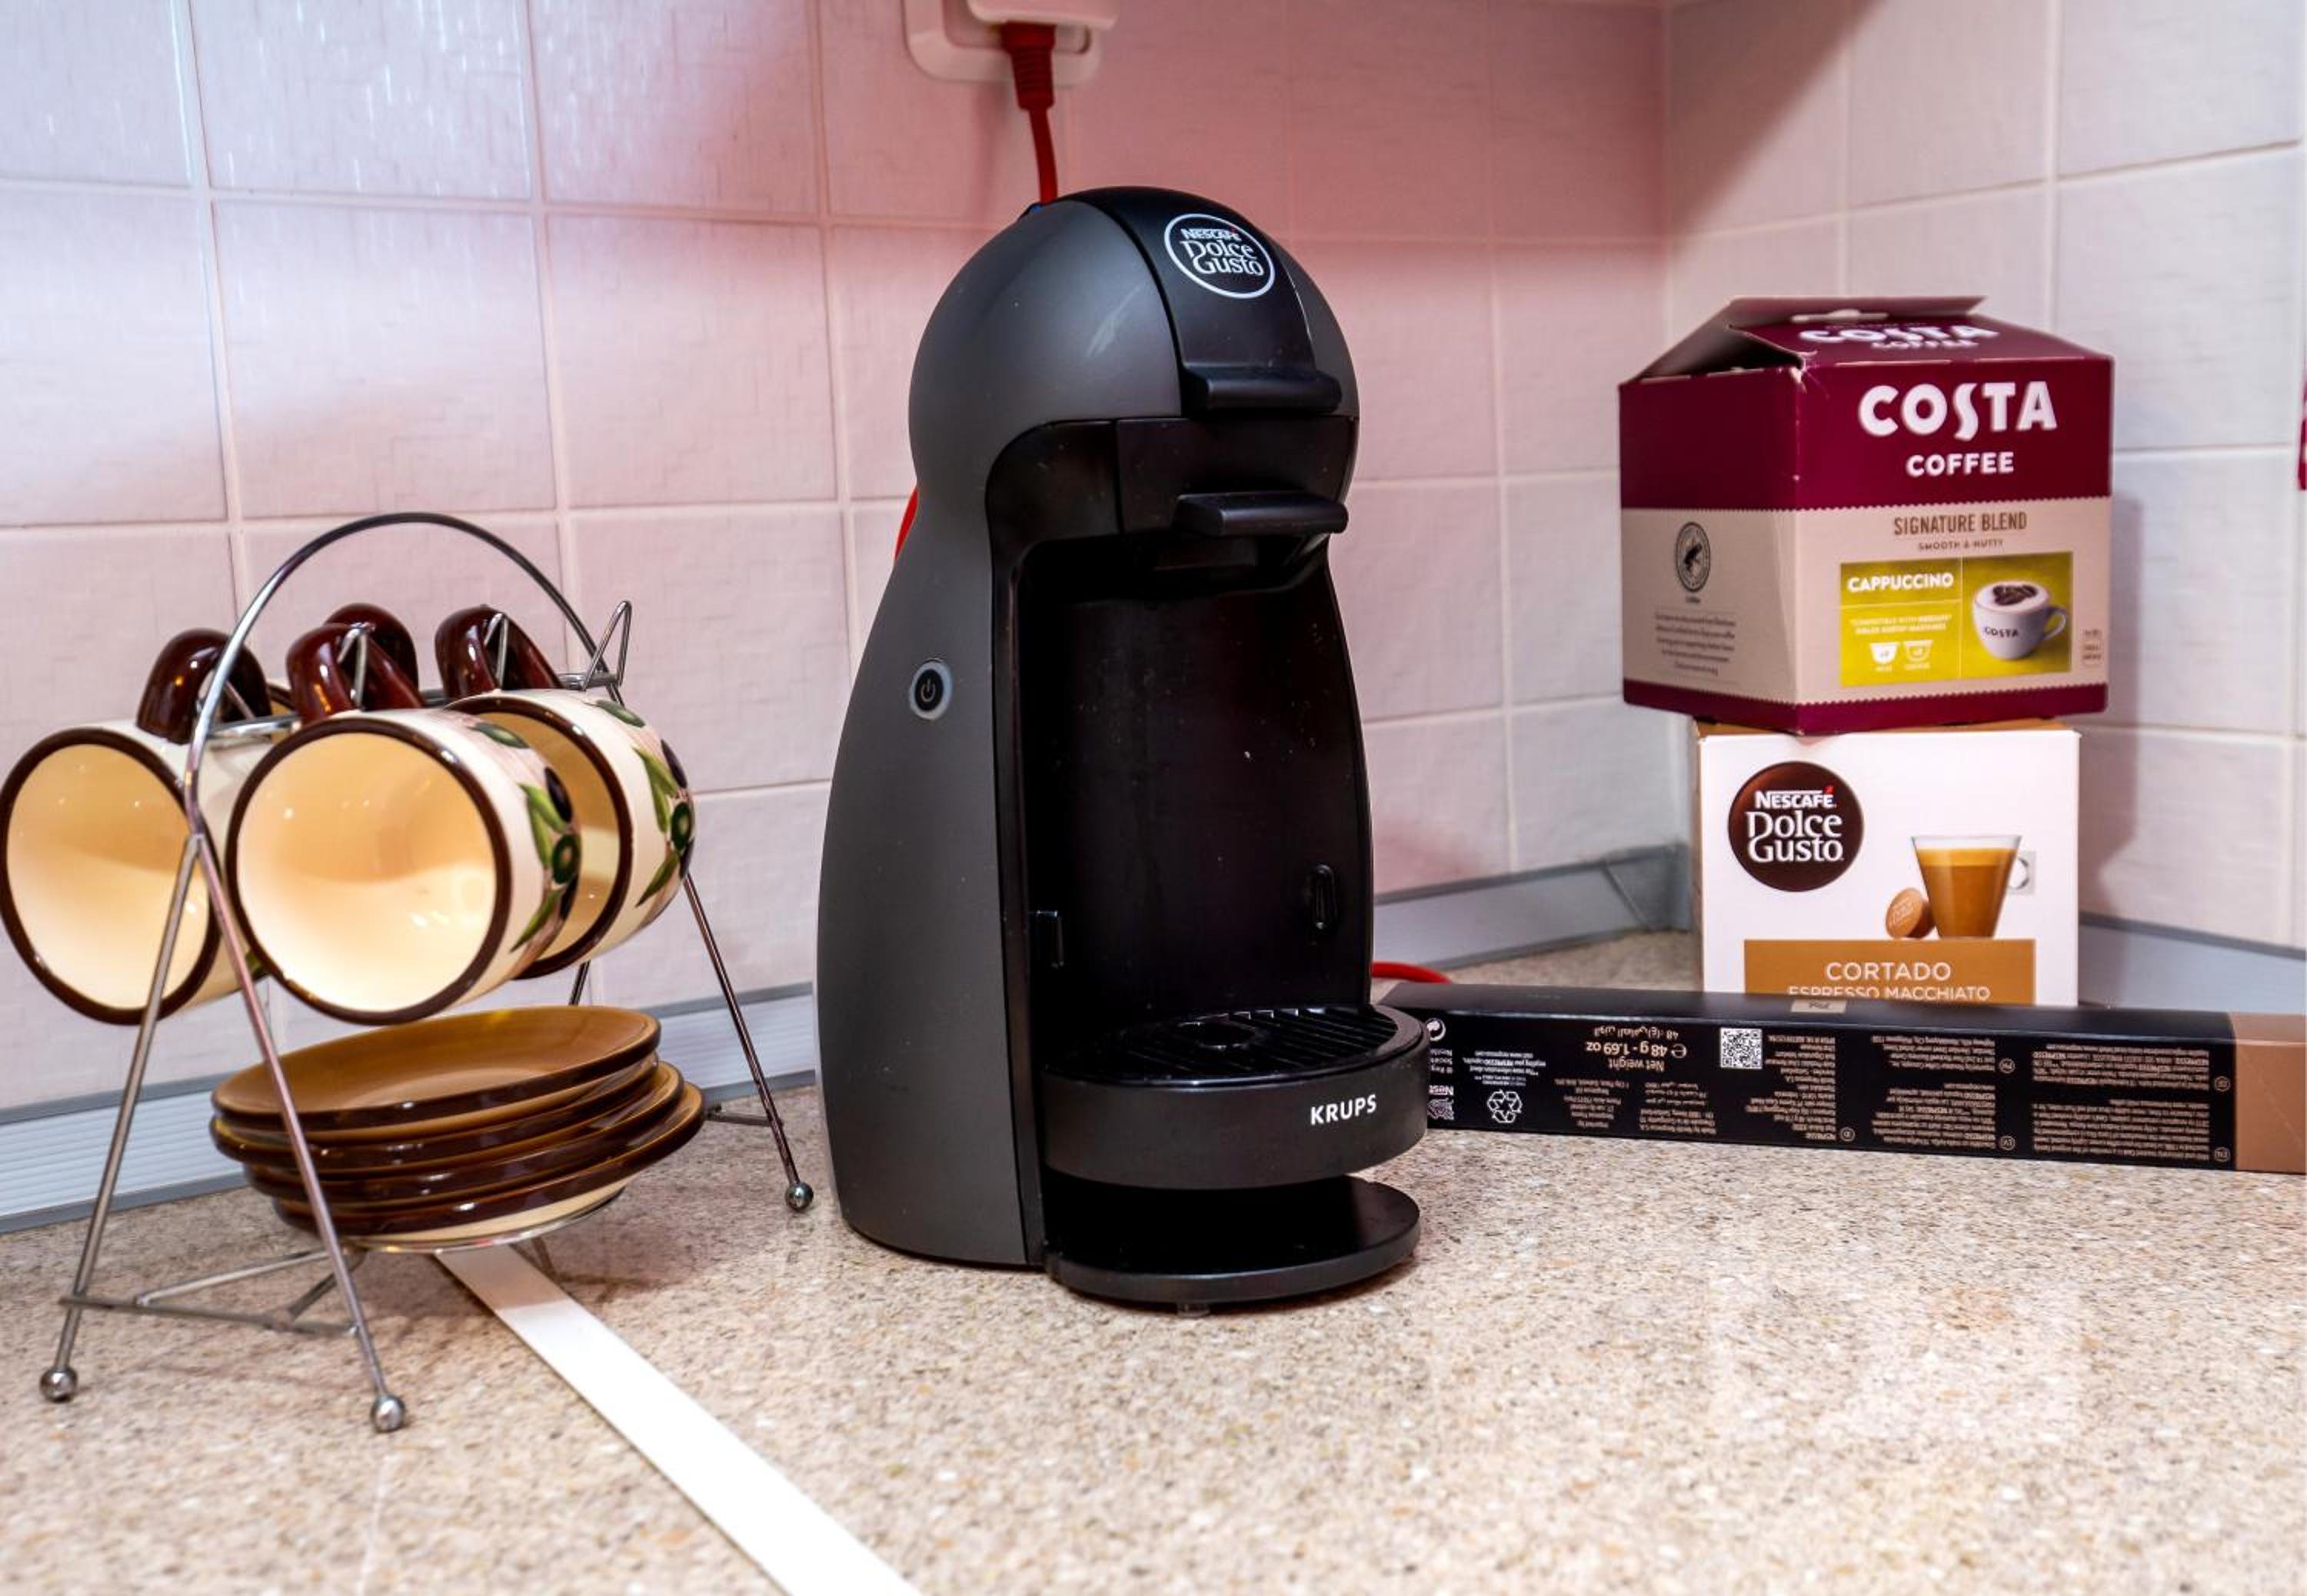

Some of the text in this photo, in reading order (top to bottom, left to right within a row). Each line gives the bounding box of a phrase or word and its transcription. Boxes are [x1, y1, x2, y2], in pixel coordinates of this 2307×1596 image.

[1180, 240, 1257, 260] Dolce
[1193, 256, 1264, 276] Gusto
[1797, 324, 1999, 343] COSTA
[1858, 381, 2058, 441] COSTA
[1906, 451, 2015, 477] COFFEE
[1894, 511, 2027, 535] SIGNATURE BLEND
[1919, 540, 1960, 550] SMOOTH
[1973, 539, 2004, 548] NUTTY
[1847, 572, 1955, 593] CAPPUCCINO
[1984, 627, 2019, 638] COSTA
[1754, 785, 1836, 809] NESCAFÉ
[1745, 811, 1843, 840] Dolce
[1747, 836, 1843, 863] Gusto
[1826, 962, 1951, 981] CORTADO
[1789, 986, 1990, 1000] ESPRESSO MACCHIATO
[1586, 1042, 1601, 1052] oz
[1603, 1042, 1630, 1055] 1.69
[1640, 1040, 1649, 1054] g
[1651, 1045, 1668, 1057] 48
[1608, 1056, 1665, 1072] Net weight
[1310, 1093, 1377, 1126] KRUPS
